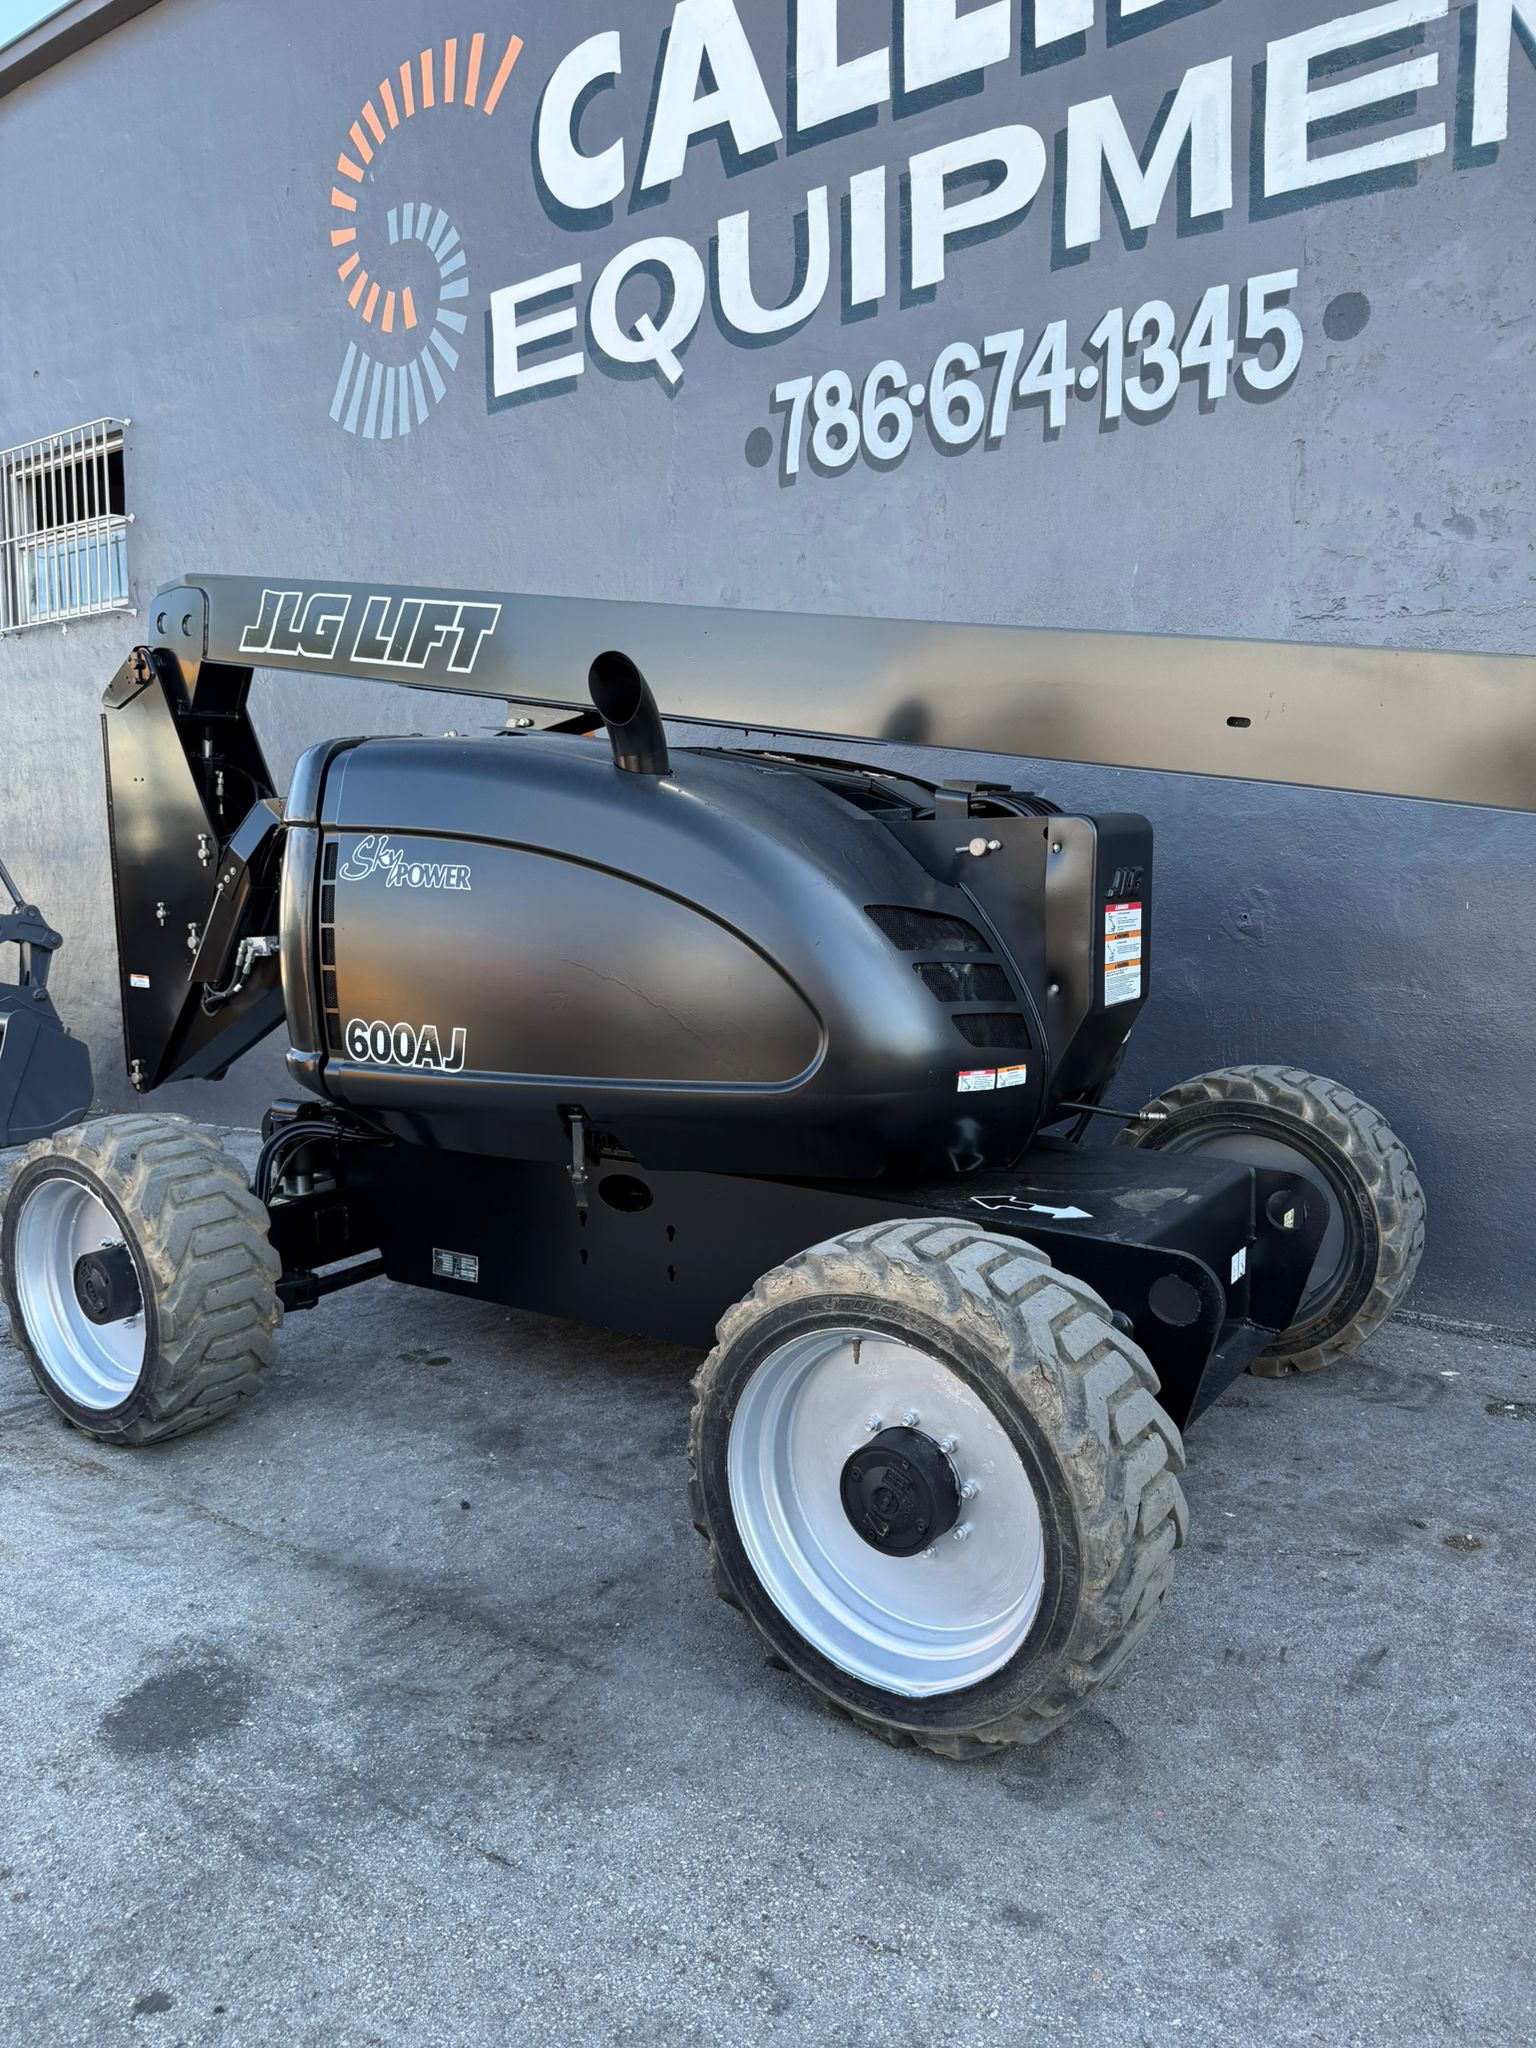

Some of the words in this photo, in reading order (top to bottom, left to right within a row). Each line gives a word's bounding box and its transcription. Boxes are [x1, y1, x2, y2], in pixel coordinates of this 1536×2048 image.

[240, 590, 350, 659] JLG
[351, 596, 502, 673] LIFT
[345, 1018, 467, 1073] 600AJ
